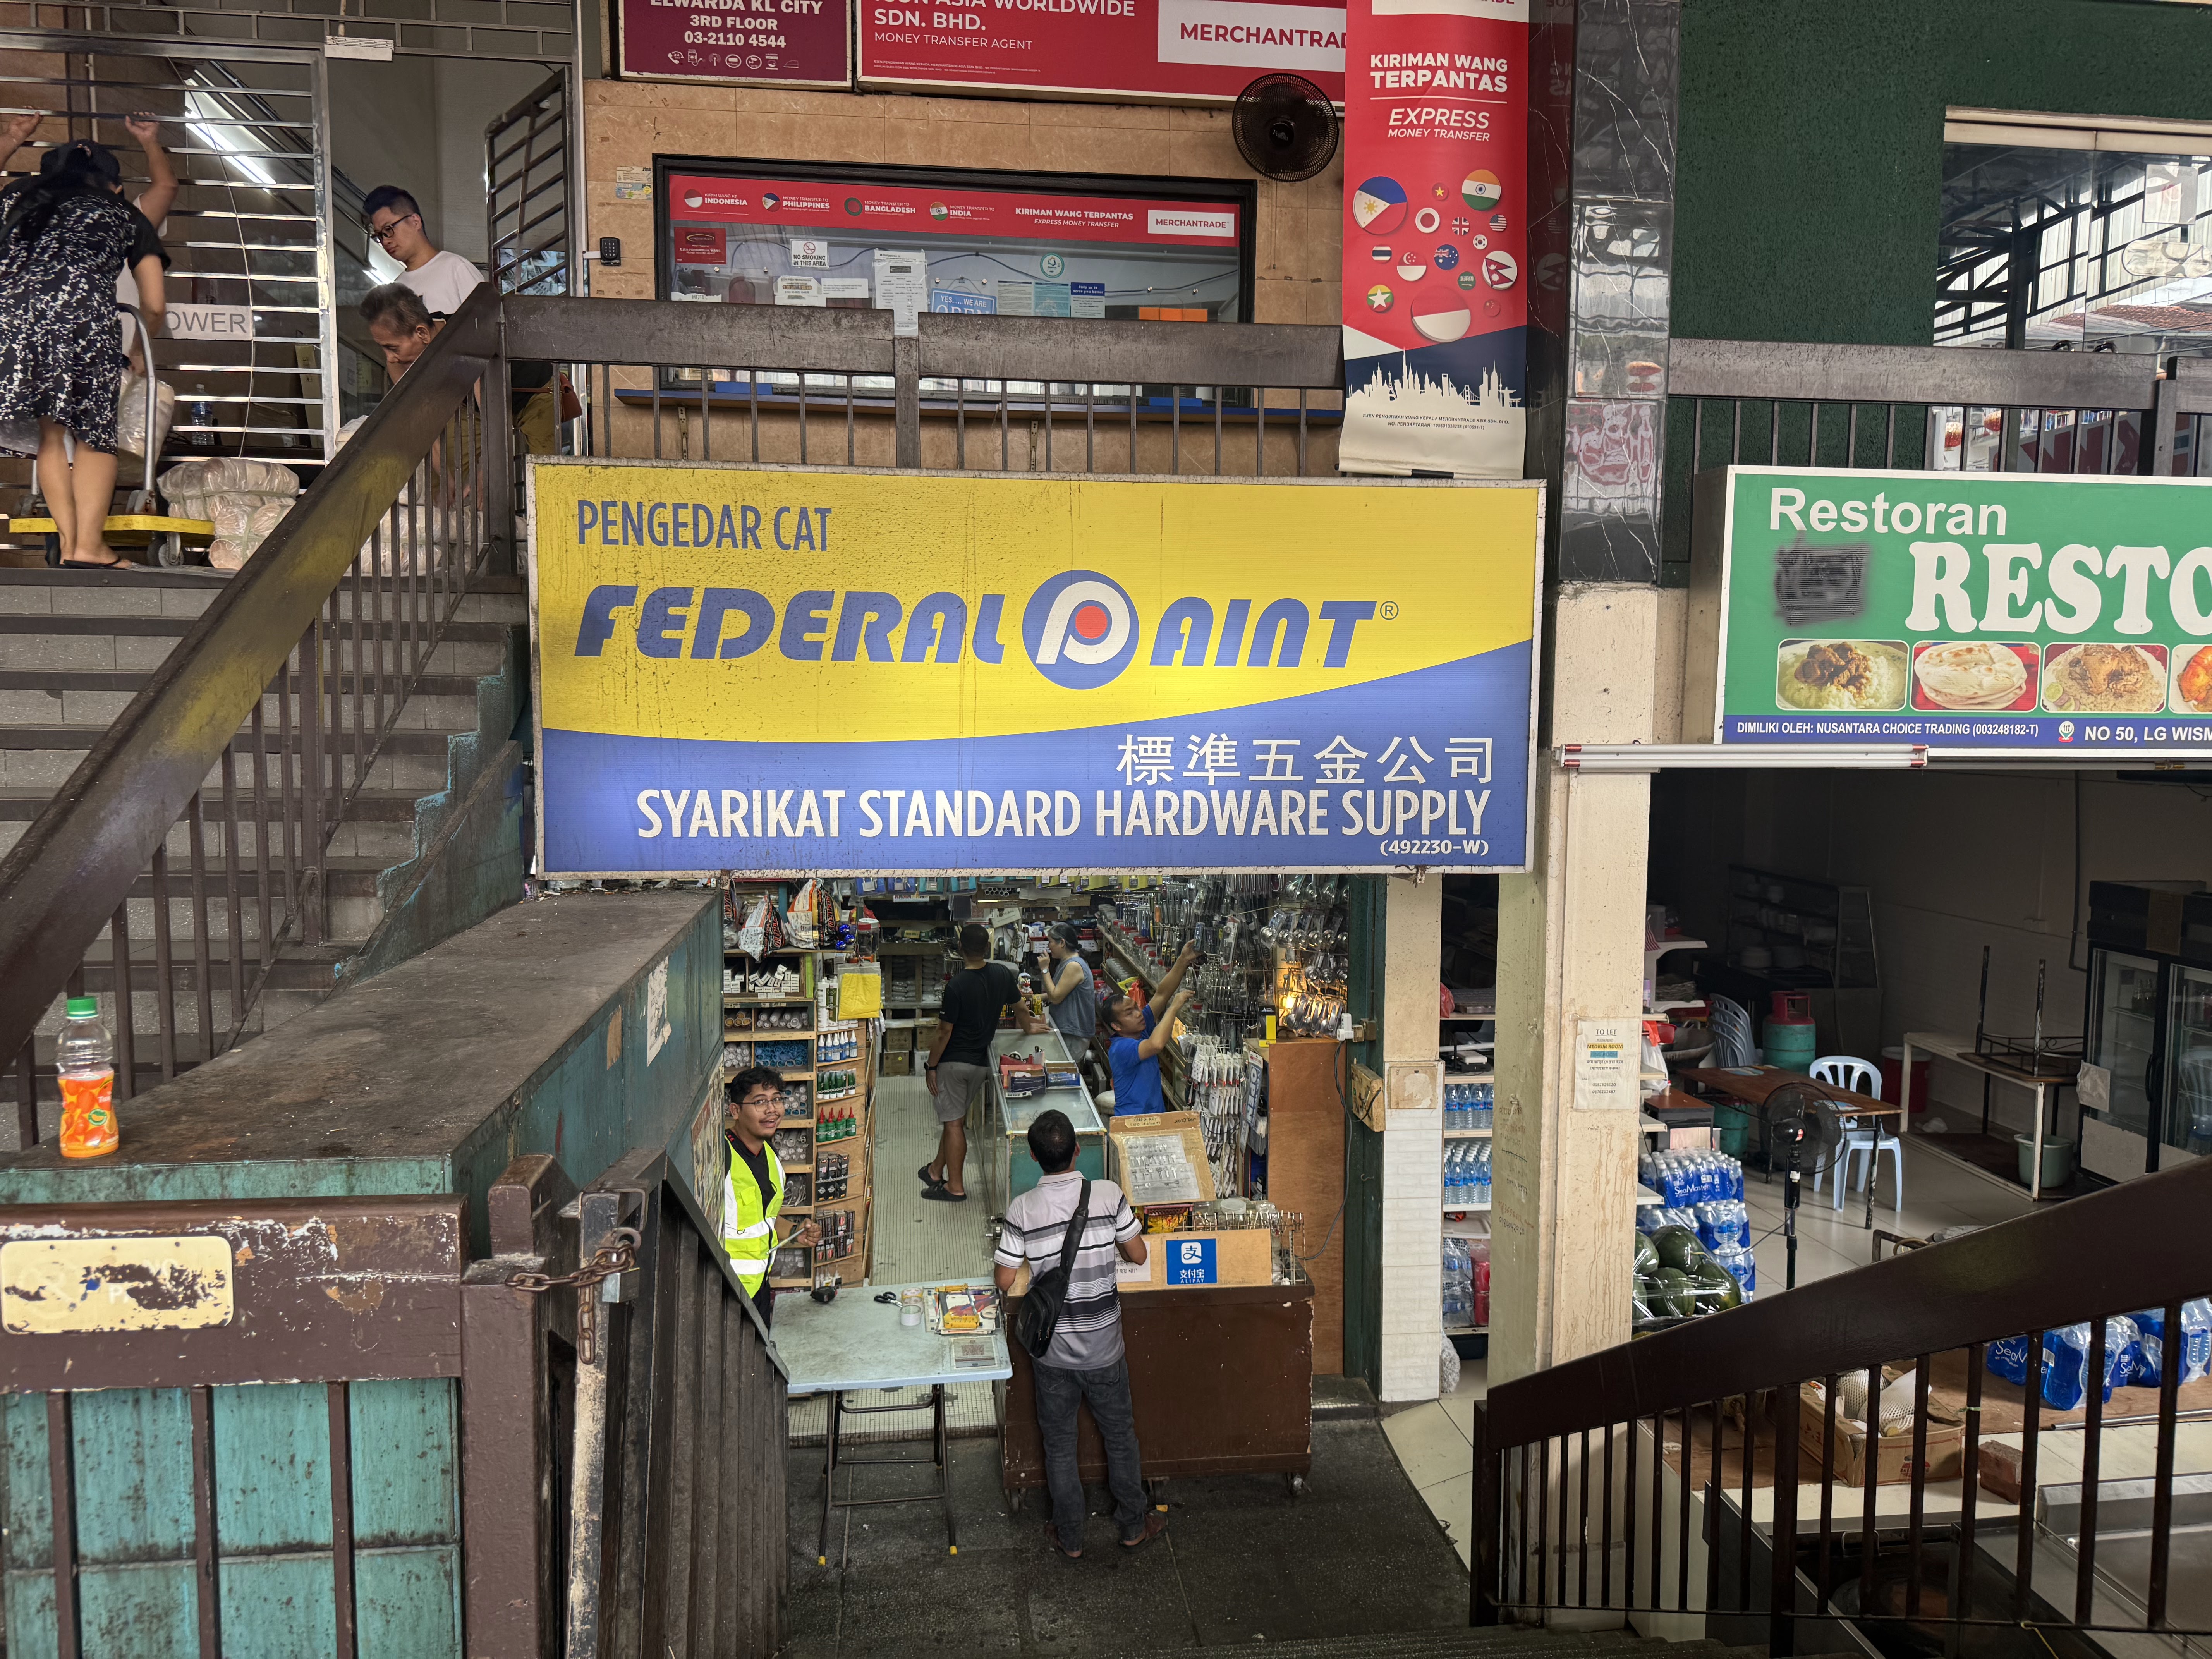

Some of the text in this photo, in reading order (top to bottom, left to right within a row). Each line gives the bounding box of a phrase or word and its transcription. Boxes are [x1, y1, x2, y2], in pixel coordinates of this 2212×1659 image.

[752, 0, 775, 12] KL
[781, 0, 823, 14] CITY
[690, 15, 778, 30] 3RD FLOOR
[874, 9, 986, 31] SDN. BHD.
[684, 31, 786, 48] 03-2110 4544
[874, 32, 1032, 50] MONEY TRANSFER AGENT
[1370, 53, 1508, 72] KIRIMAN WANG
[1370, 70, 1508, 93] TERPANTAS
[1389, 108, 1490, 129] EXPRESS
[1388, 128, 1490, 142] MONEY TRANSFER
[705, 198, 748, 206] INDONESIA
[783, 201, 830, 209] PHILIPPINES
[864, 205, 916, 214] BANGLADESH
[1015, 208, 1133, 220] KIRIMAN WANG TERPANTAS
[1156, 218, 1226, 228] MERCHANTRADE
[1769, 487, 2007, 536] Restoran
[577, 500, 832, 551] PENGEDAR CAT
[1905, 541, 2212, 636] RESTO
[574, 584, 1006, 665] FEDERAL
[1737, 722, 2039, 737] DIMILIKI OLEH: NUSANTARA CHOICE TRADING (003248182-T)
[2085, 726, 2110, 740] NO
[2115, 726, 2138, 743] 50,
[2144, 727, 2167, 741] LG
[1117, 733, 1493, 787] 標準五金公司
[637, 789, 1491, 838] SYARIKAT STANDARD HARDWARE SUPPLY
[1379, 840, 1489, 856] (492230-W)
[1180, 1269, 1204, 1279] 支付宝
